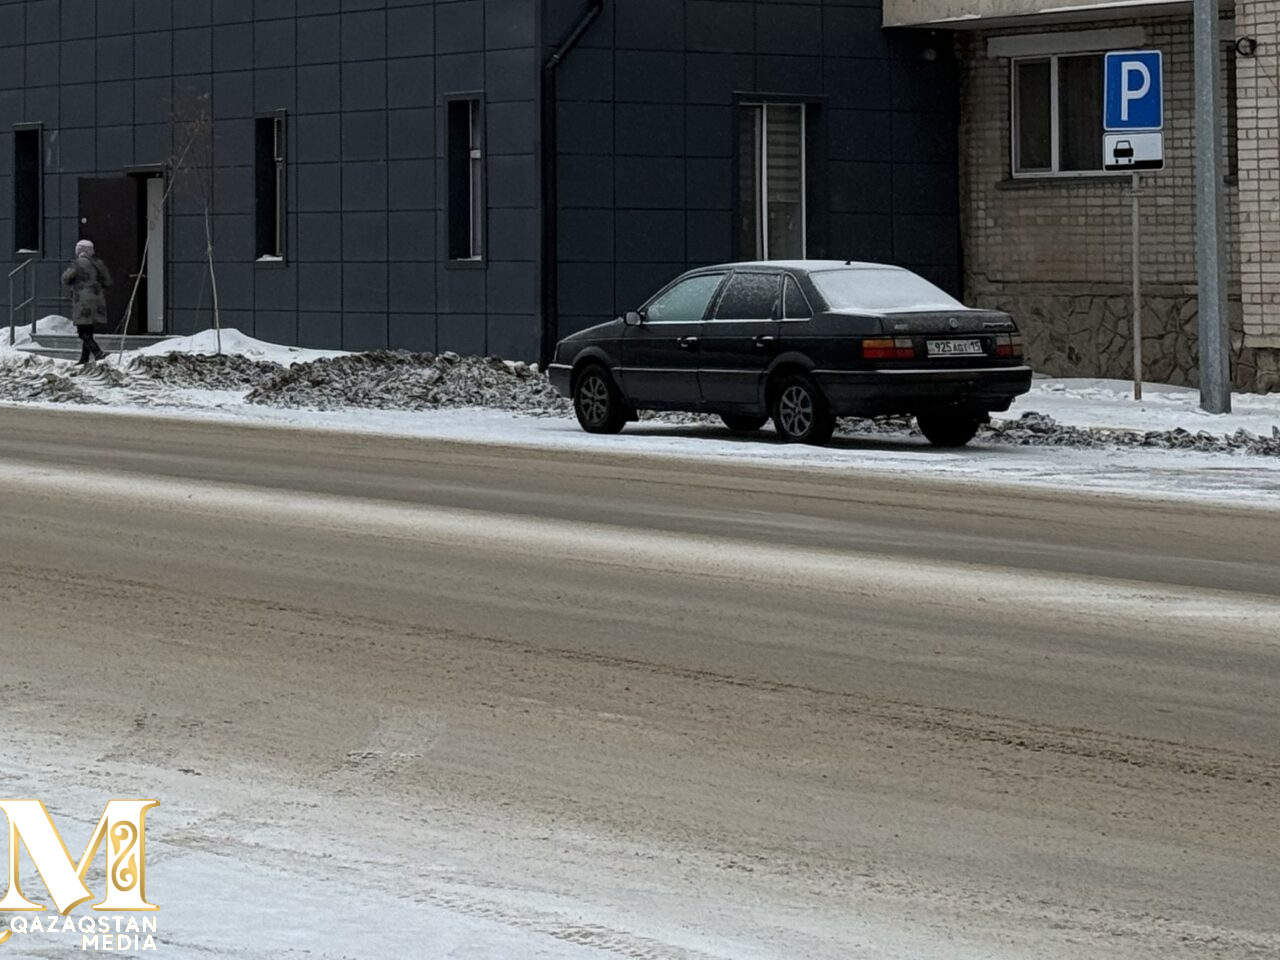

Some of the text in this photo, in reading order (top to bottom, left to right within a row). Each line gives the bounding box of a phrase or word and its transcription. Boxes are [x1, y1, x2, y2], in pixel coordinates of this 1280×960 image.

[1121, 61, 1151, 121] P
[935, 341, 952, 353] 925
[969, 341, 981, 352] 15
